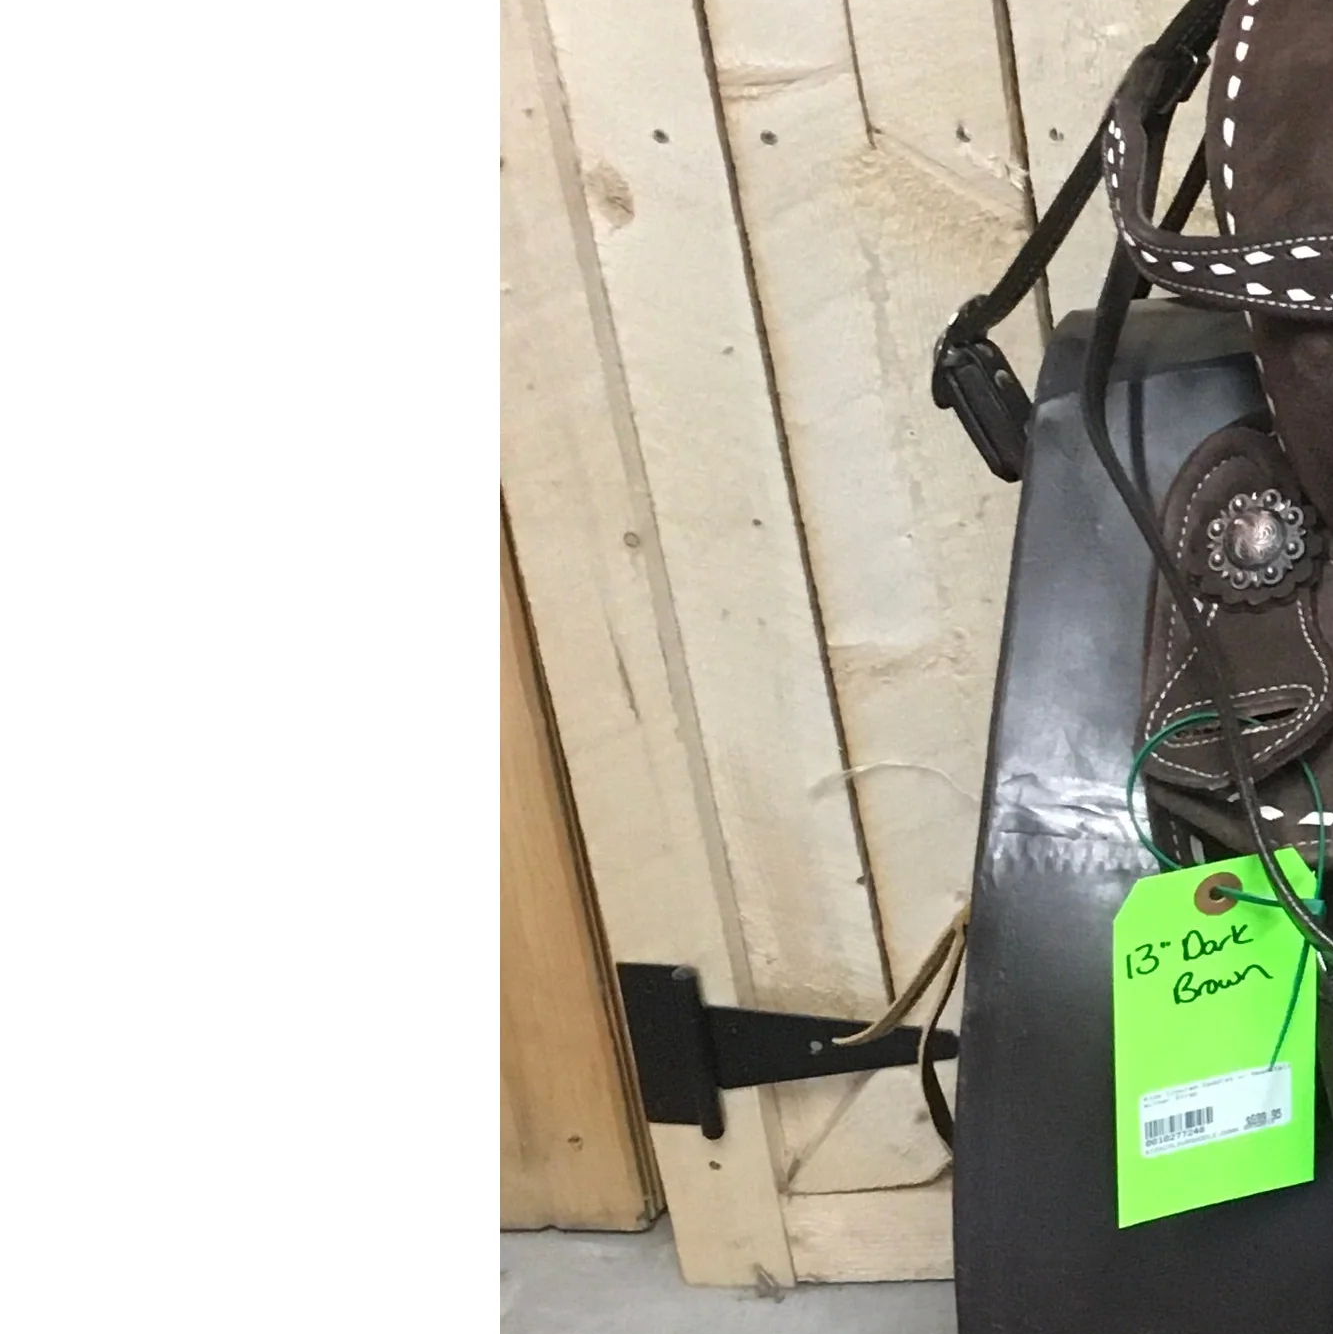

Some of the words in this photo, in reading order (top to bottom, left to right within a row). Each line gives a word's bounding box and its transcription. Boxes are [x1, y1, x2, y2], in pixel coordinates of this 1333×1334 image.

[1126, 941, 1171, 979] 13"
[1182, 924, 1254, 961] Dark
[1173, 964, 1274, 1004] Brown
